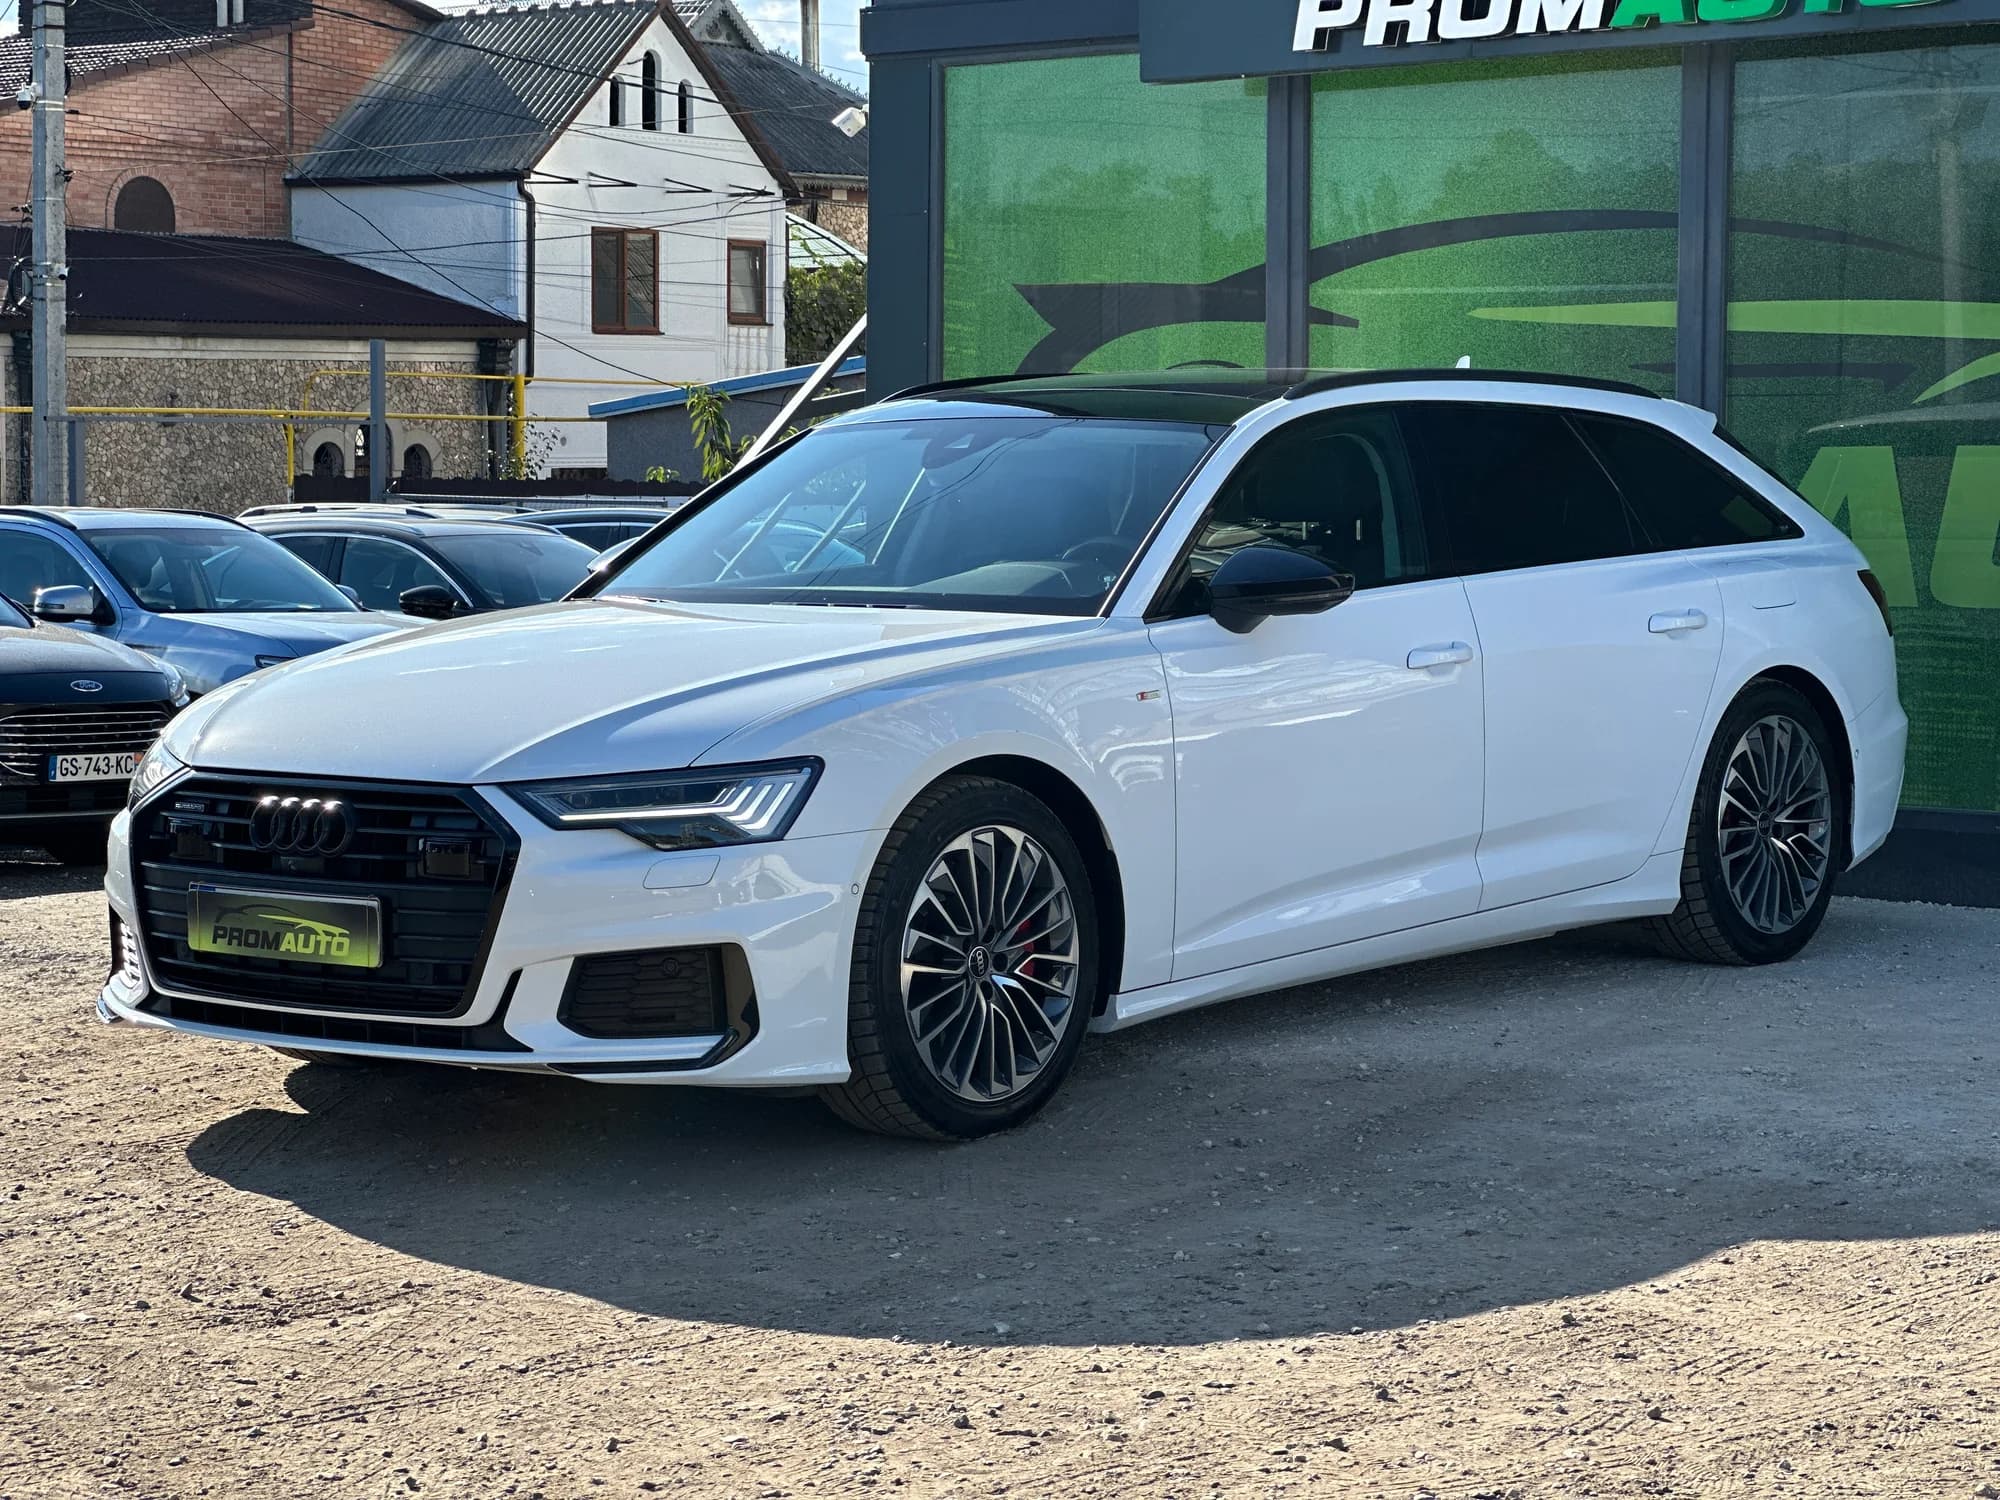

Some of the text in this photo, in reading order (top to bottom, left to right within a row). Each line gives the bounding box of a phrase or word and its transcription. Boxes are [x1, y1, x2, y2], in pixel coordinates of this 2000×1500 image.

[1292, 0, 1950, 51] PROM
[59, 755, 134, 777] GS-743-KC
[212, 925, 350, 957] PROMAUTO
